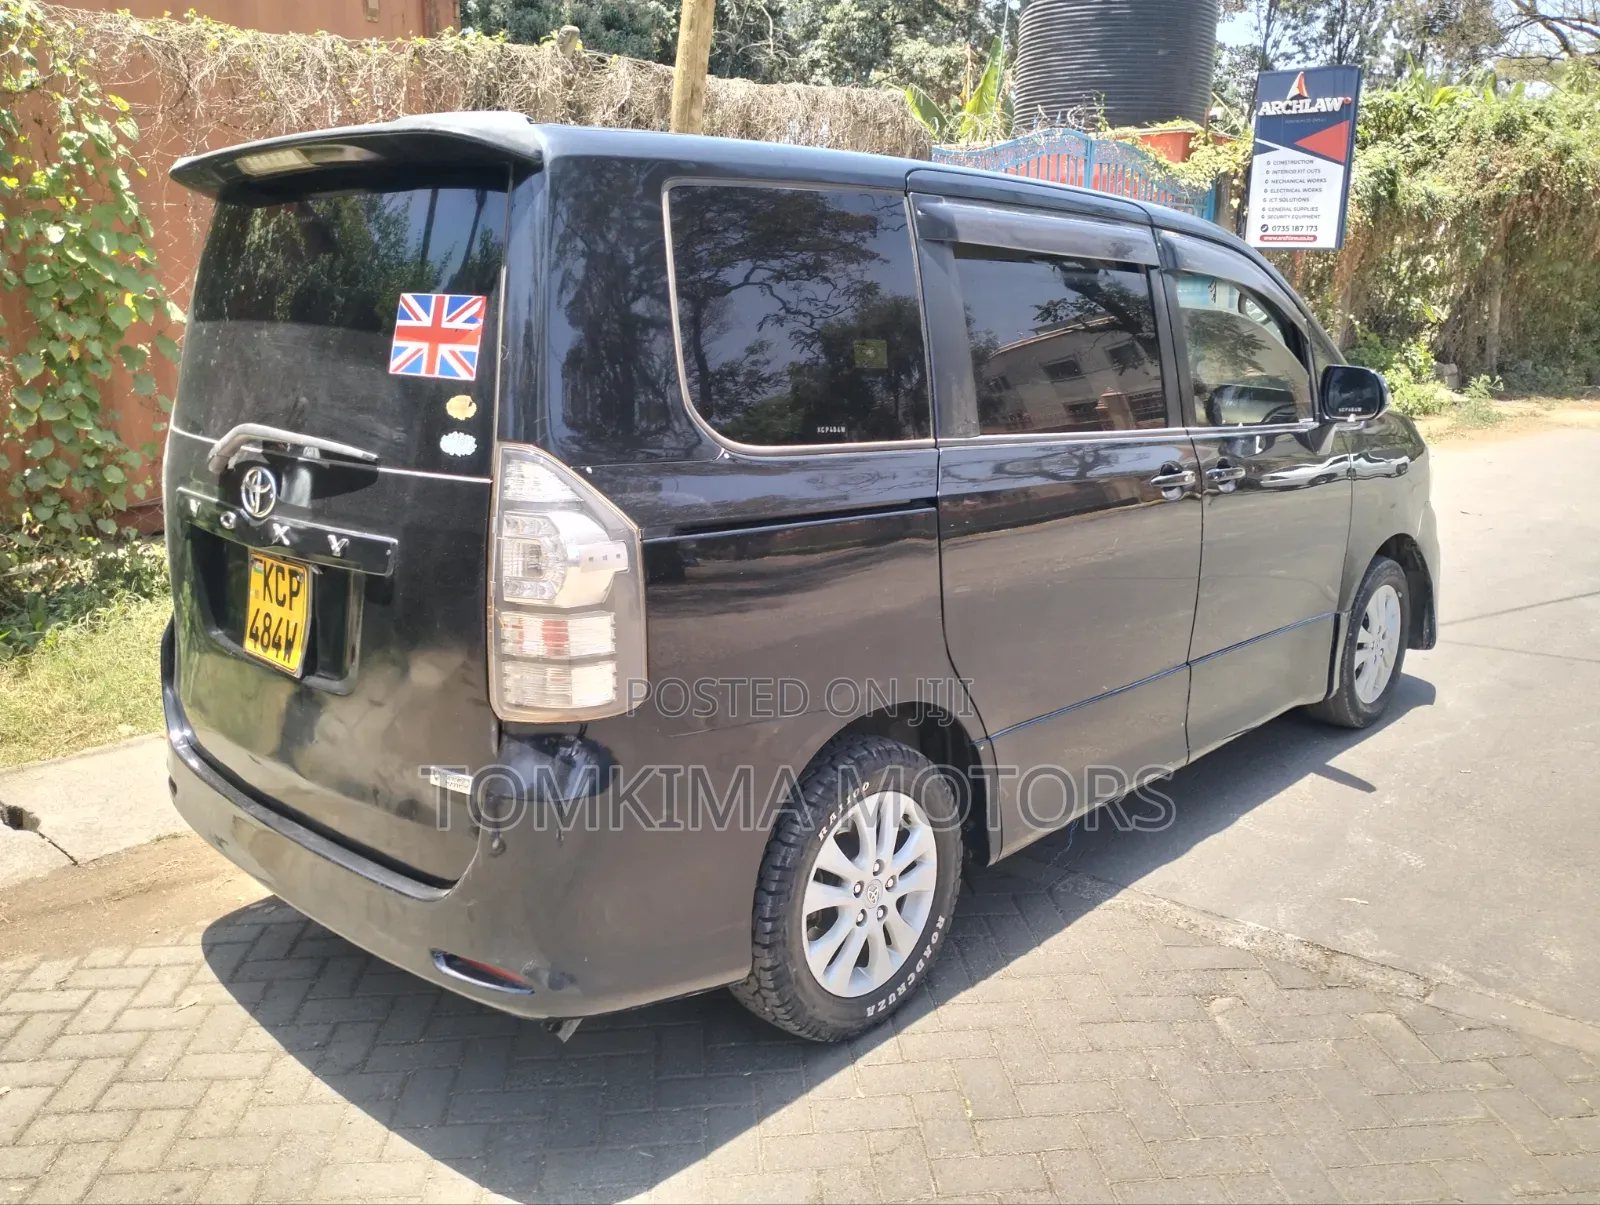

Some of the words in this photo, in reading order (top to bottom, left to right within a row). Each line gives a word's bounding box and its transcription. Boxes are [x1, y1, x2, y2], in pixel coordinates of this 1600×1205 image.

[1258, 97, 1345, 115] ARCHLAW
[262, 560, 300, 611] KCP
[249, 608, 298, 664] 484W
[866, 915, 946, 1017] ROADCRUZA
